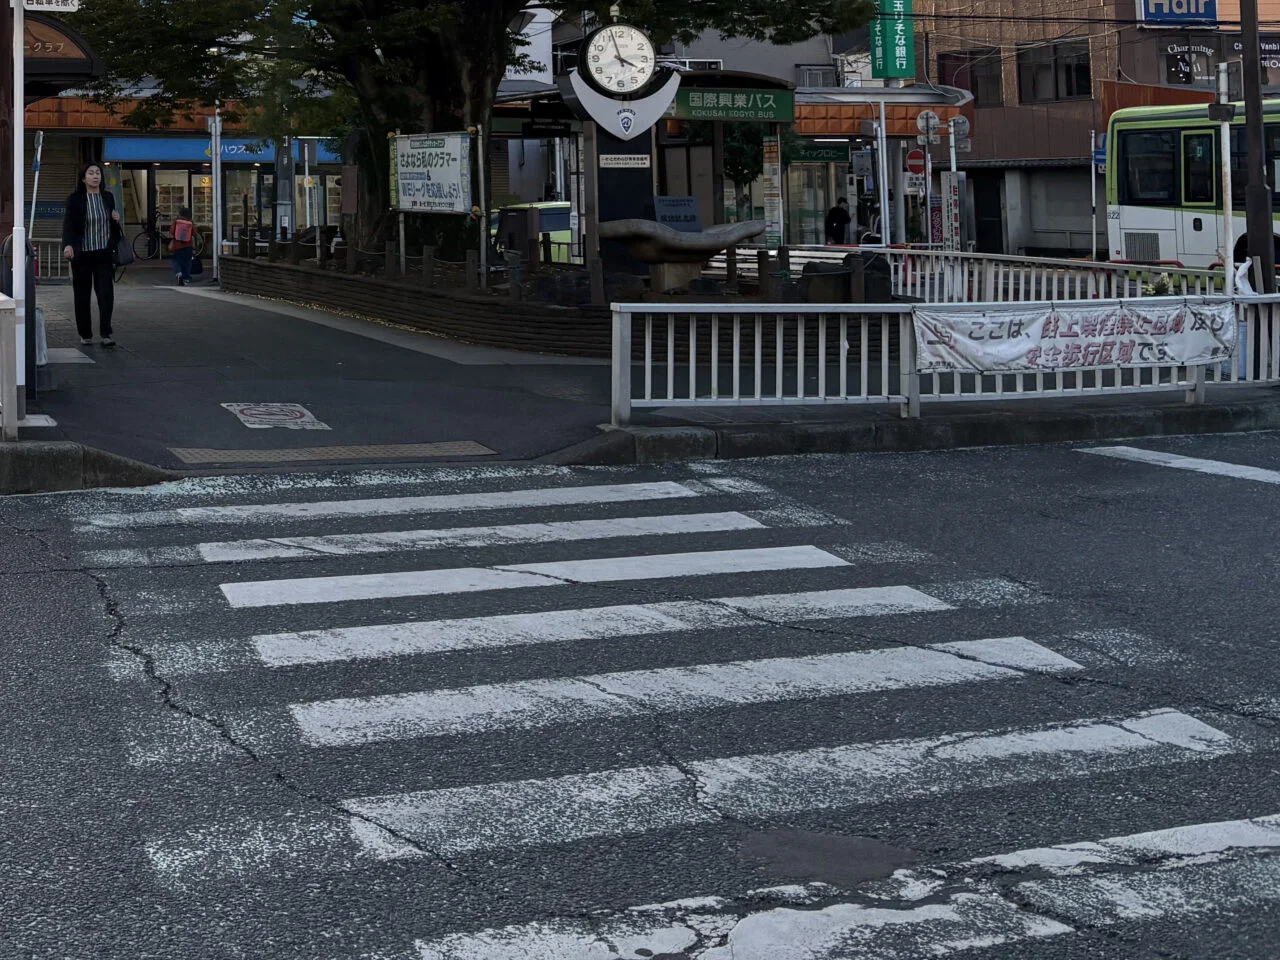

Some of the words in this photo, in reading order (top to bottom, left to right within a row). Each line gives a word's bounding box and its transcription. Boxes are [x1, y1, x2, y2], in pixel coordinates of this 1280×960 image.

[1167, 44, 1215, 56] Charming
[689, 92, 776, 109] 国際興業バス
[692, 110, 726, 118] KOKUSAI
[758, 111, 774, 119] BUS
